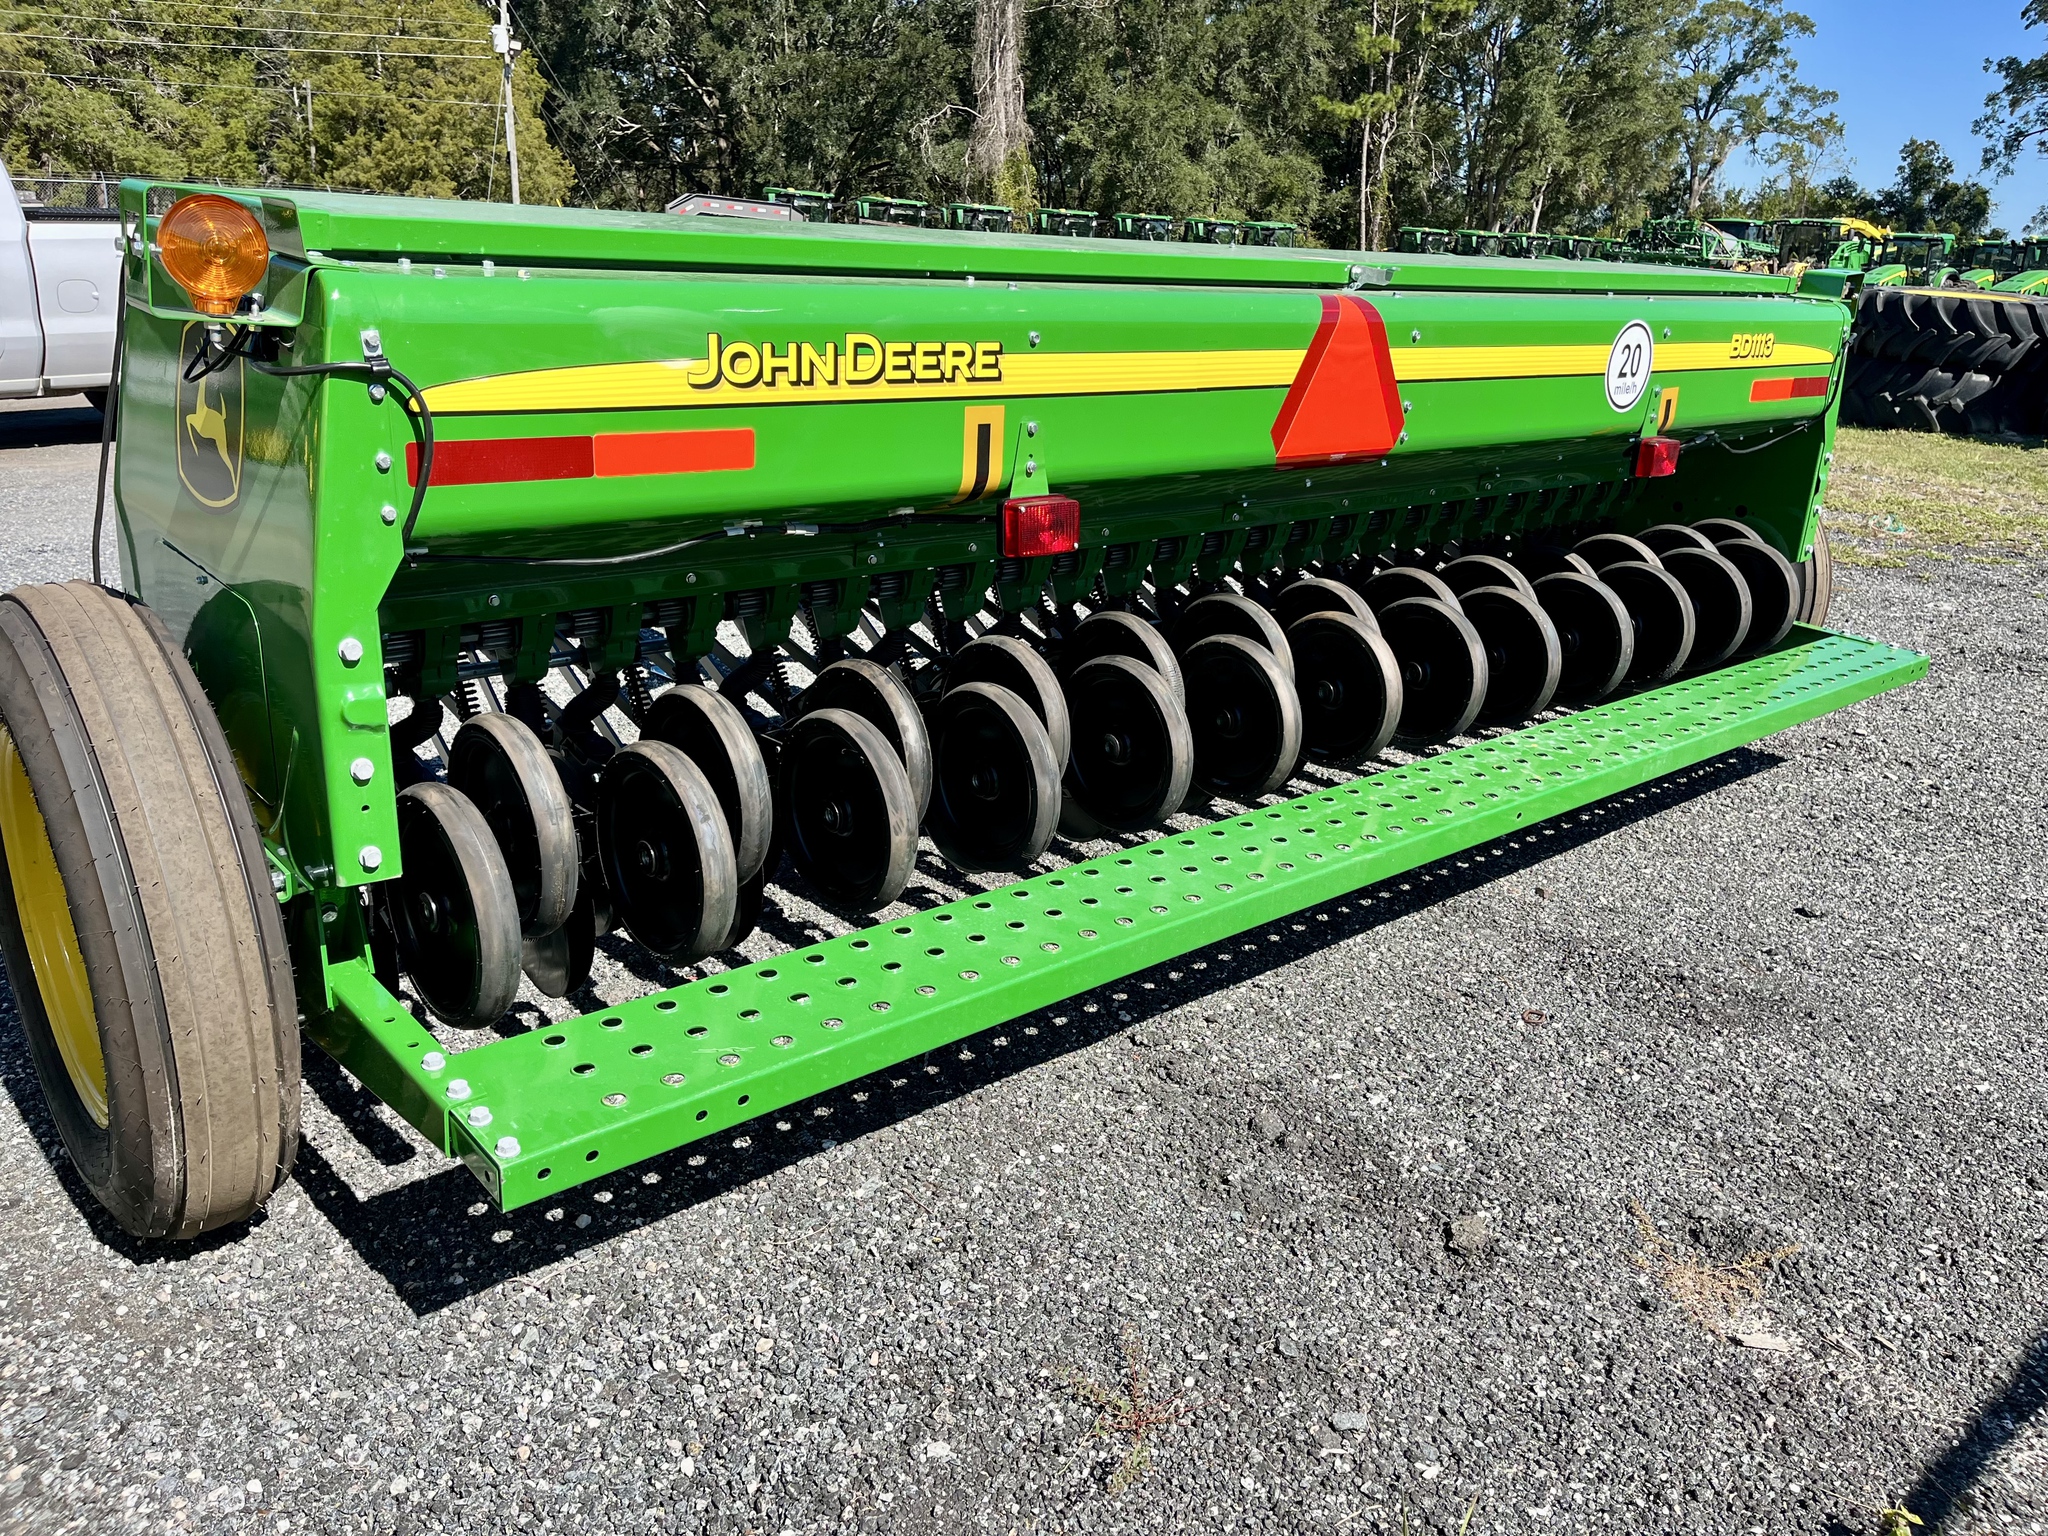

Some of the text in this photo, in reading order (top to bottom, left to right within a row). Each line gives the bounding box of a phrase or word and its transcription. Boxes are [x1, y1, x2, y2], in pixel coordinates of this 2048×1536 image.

[688, 332, 1003, 389] JOHN DEERE
[1617, 343, 1642, 378] 20
[1729, 333, 1775, 358] BD1113
[1613, 381, 1637, 395] mile/h
